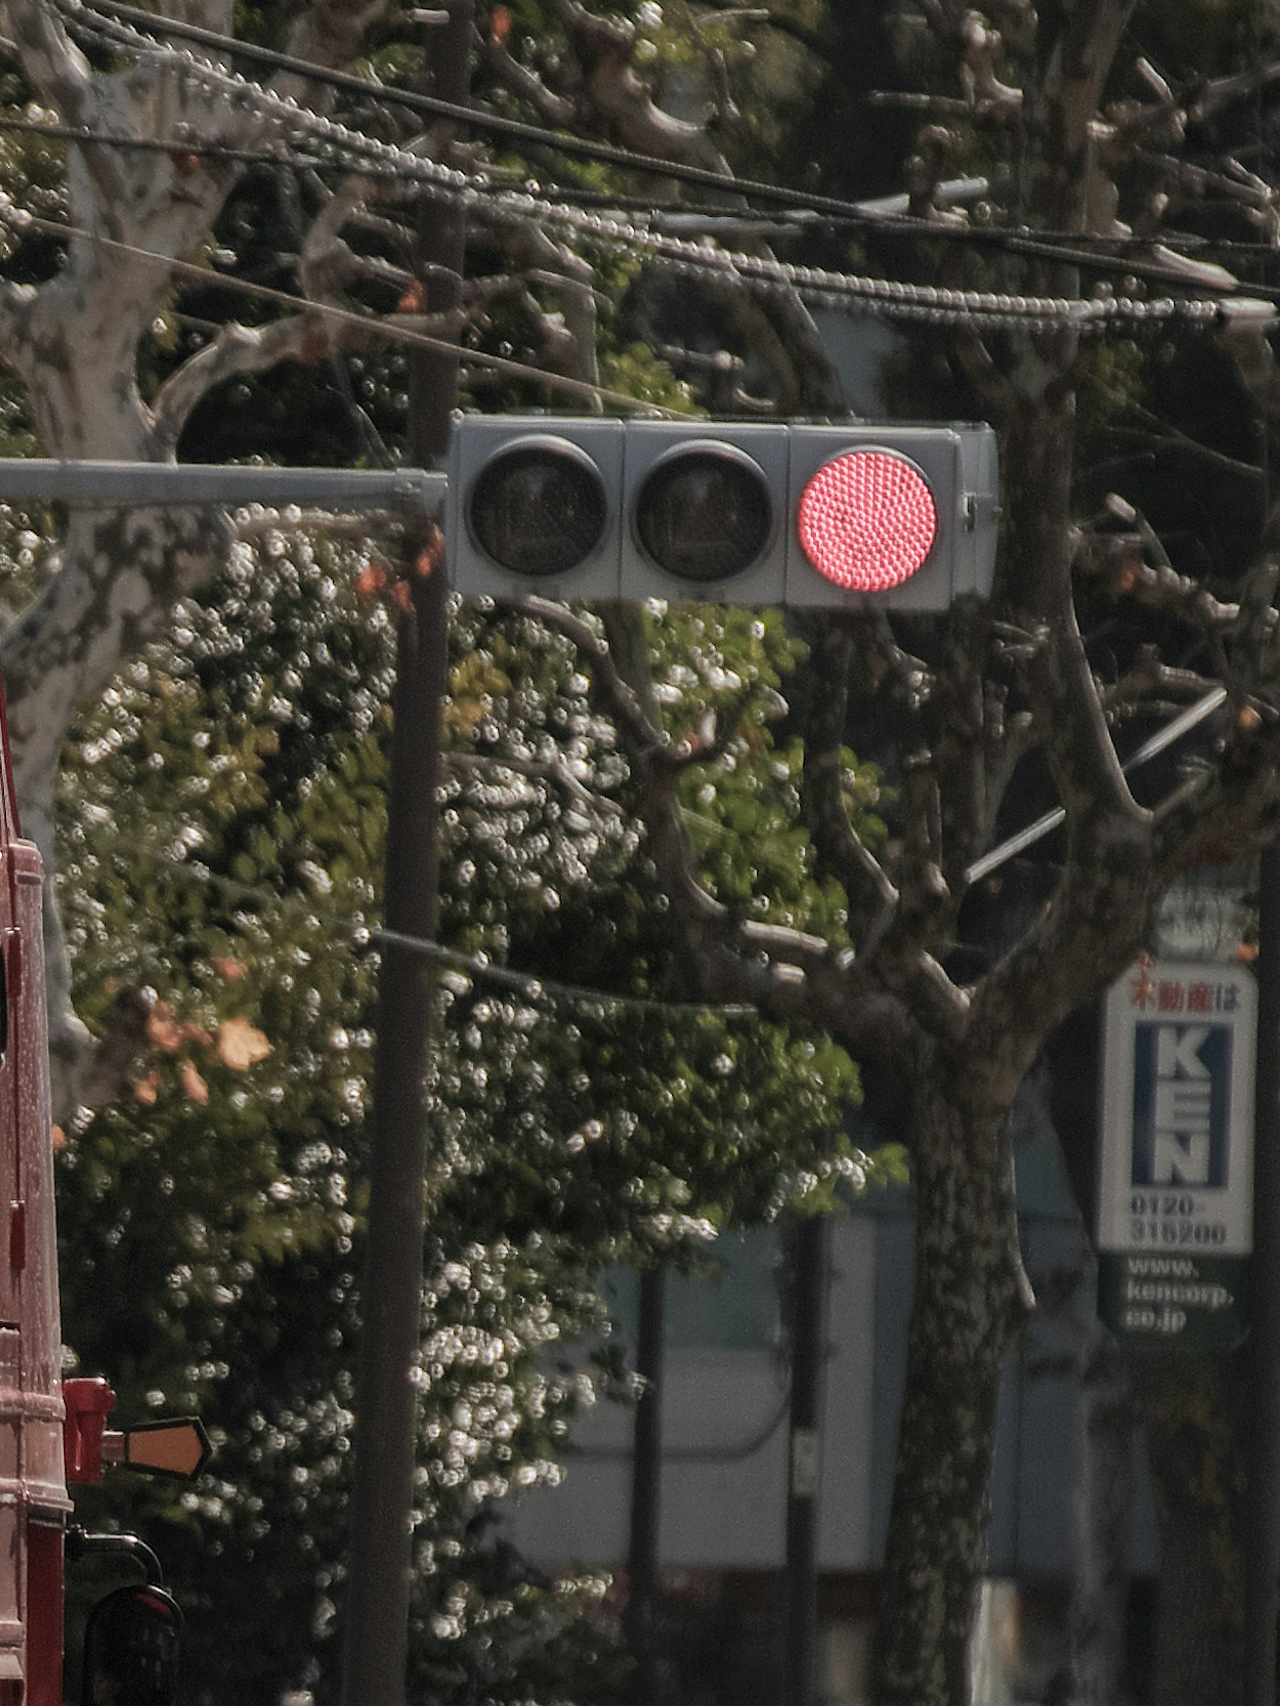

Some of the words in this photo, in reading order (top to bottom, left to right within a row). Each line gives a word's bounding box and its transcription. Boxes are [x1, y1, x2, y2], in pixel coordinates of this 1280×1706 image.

[1154, 1027, 1212, 1183] KEN
[1128, 1258, 1199, 1278] www.
[1126, 1307, 1186, 1332] co.jp
